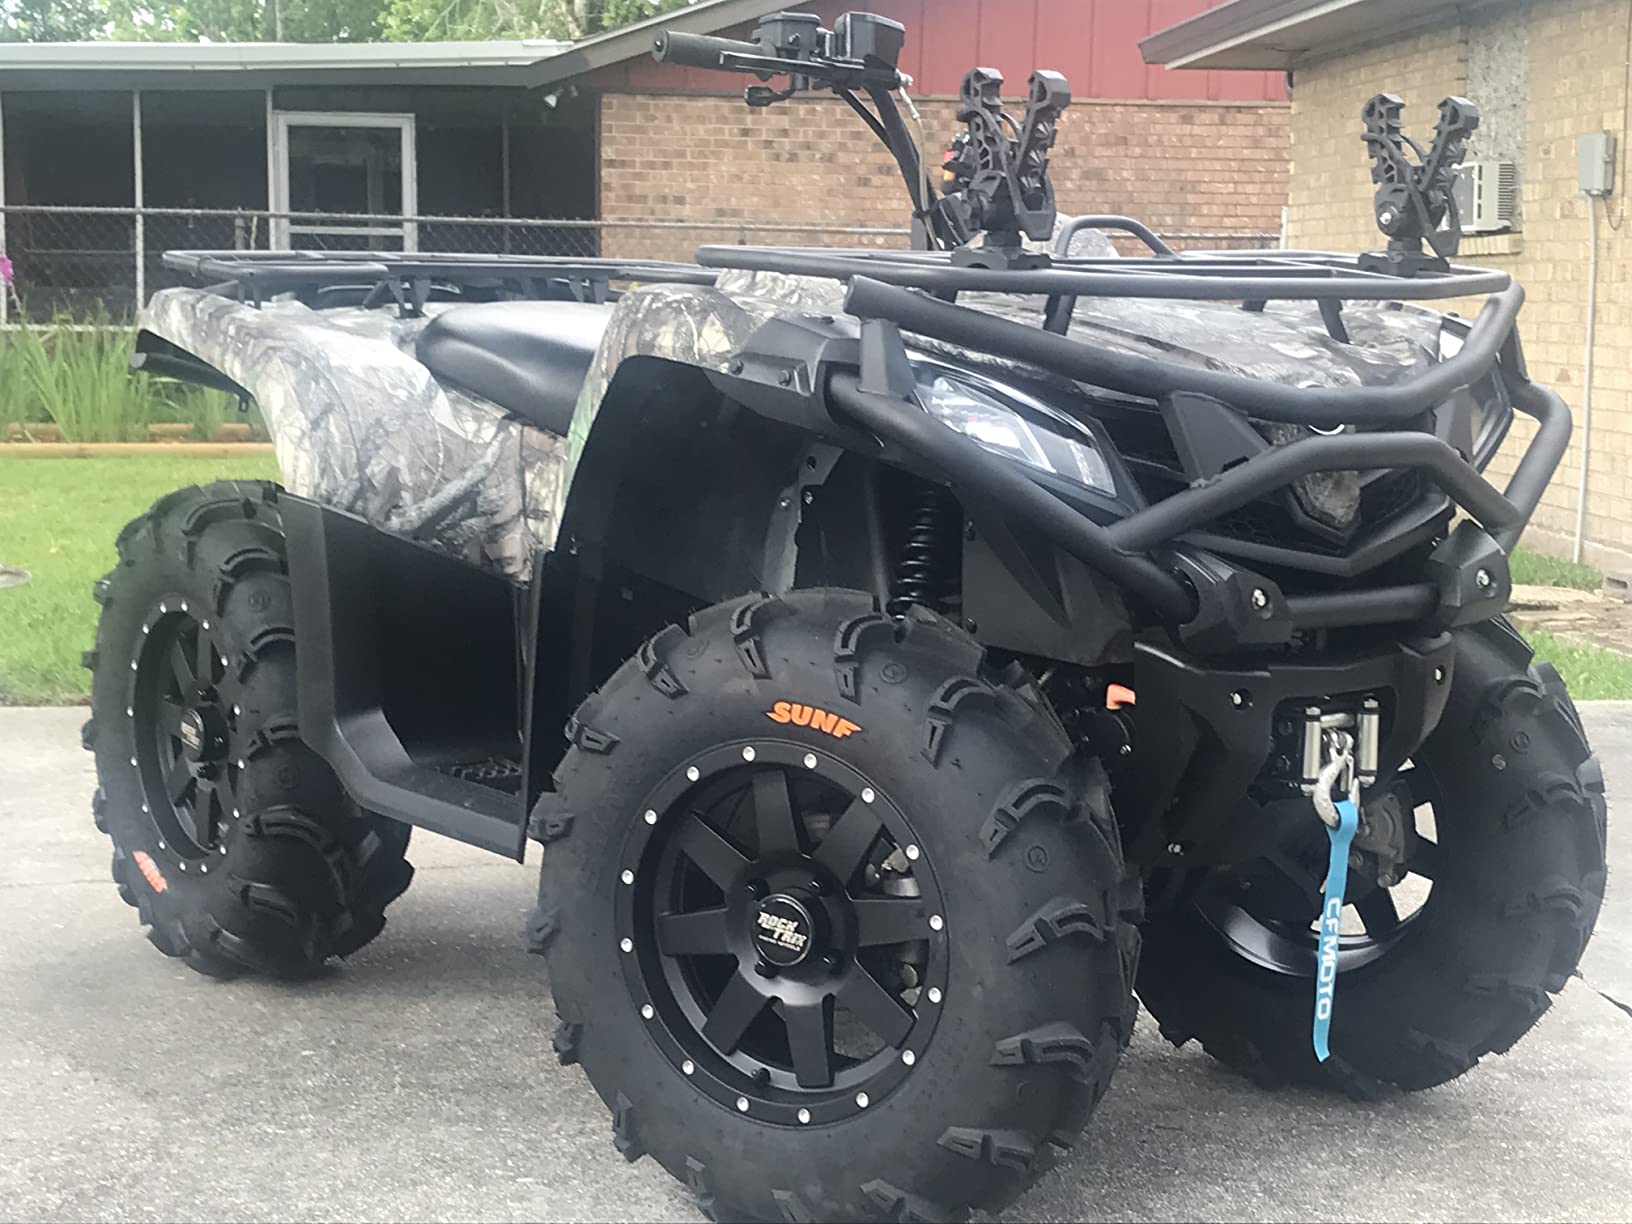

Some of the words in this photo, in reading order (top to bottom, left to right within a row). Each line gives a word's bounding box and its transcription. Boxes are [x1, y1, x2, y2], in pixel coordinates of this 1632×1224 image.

[765, 701, 862, 738] SUNF
[757, 911, 799, 932] ROCK
[1317, 897, 1341, 1020] CFMOTO
